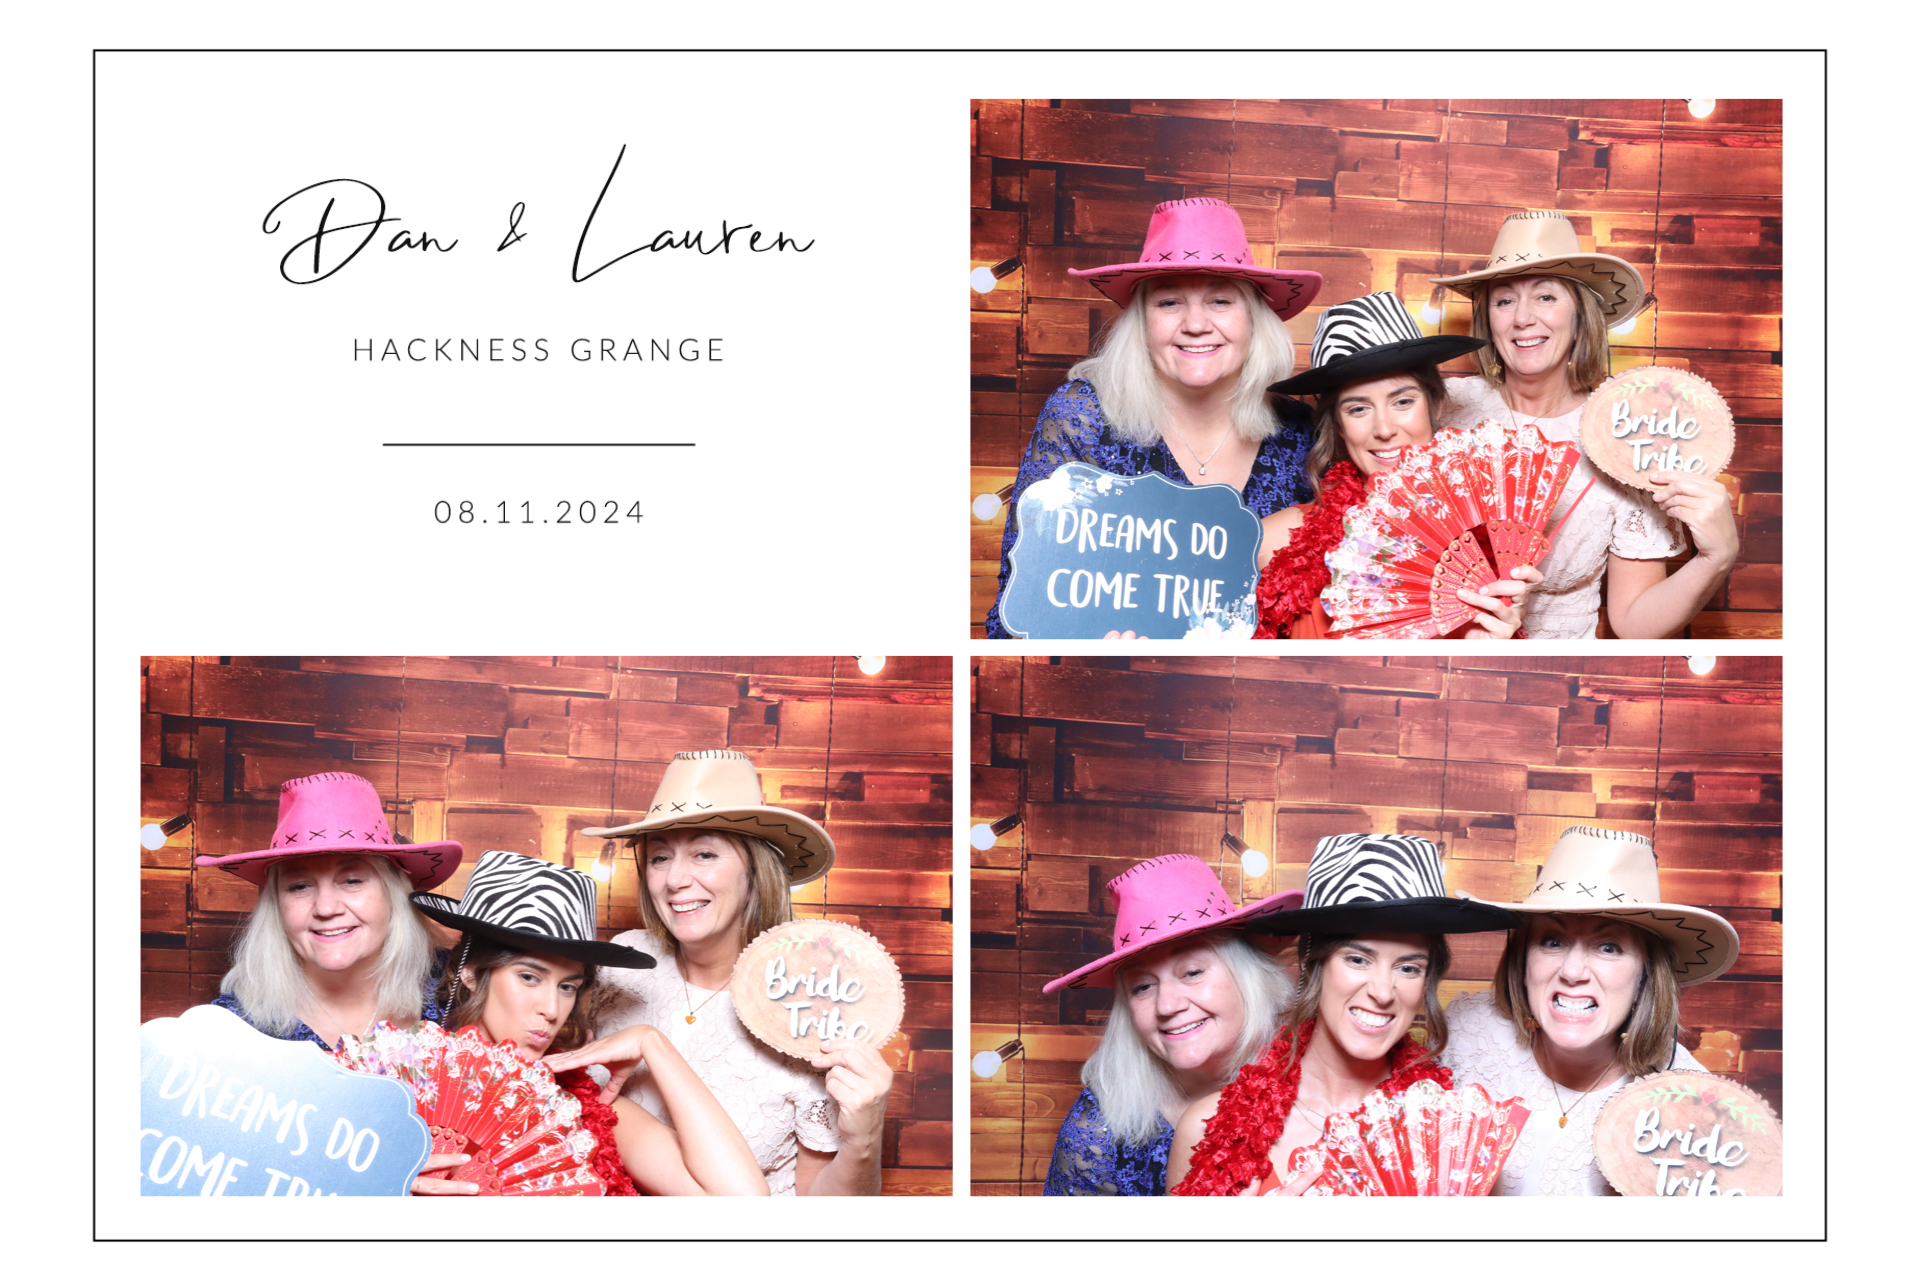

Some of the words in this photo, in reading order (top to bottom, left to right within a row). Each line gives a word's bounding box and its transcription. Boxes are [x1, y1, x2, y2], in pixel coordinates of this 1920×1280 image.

[1611, 399, 1702, 440] Bride
[1625, 438, 1709, 474] Tribe
[1056, 508, 1178, 560] DREAMS
[1191, 522, 1228, 560] DO
[1047, 568, 1141, 610] COME
[1153, 573, 1225, 619] TRUE
[765, 956, 867, 1003] Bride
[780, 1001, 876, 1042] Tribe
[159, 1055, 318, 1156] DREAMS
[325, 1117, 380, 1172] DO
[1633, 1106, 1750, 1167] Bride
